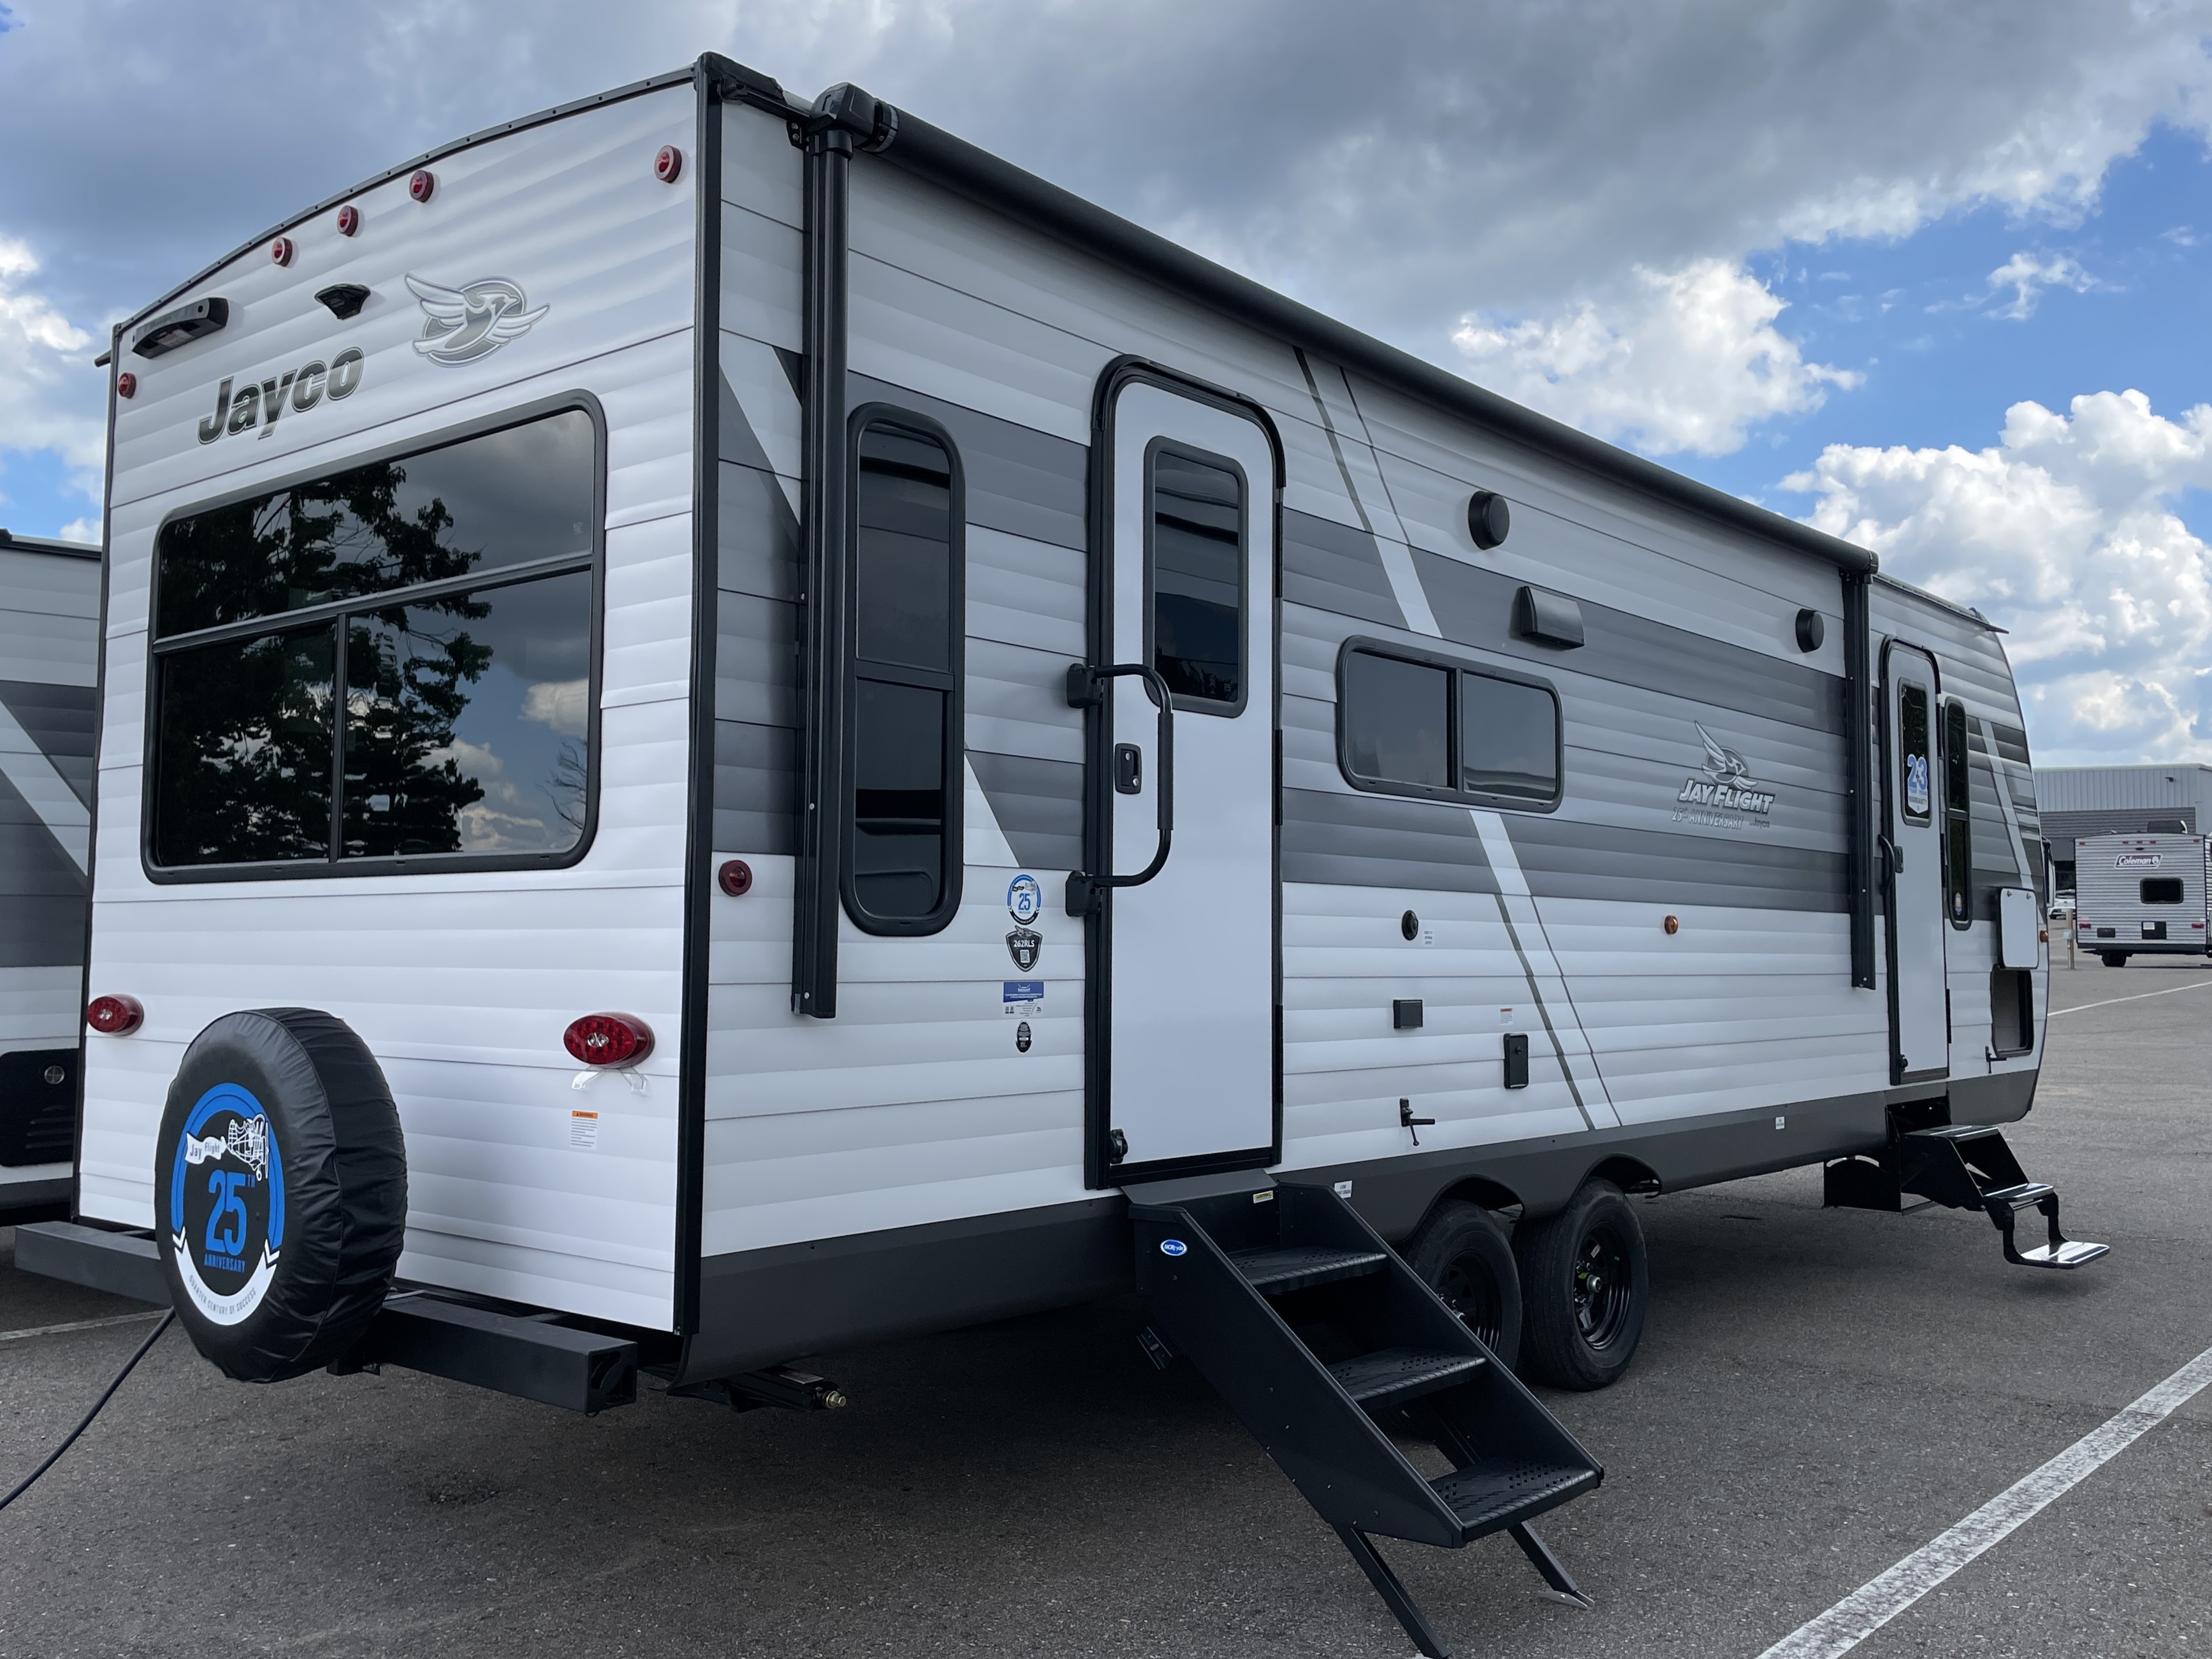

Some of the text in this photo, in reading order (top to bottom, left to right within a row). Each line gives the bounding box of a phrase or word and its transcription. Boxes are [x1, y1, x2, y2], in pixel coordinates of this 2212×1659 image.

[198, 346, 365, 445] Jayco
[1678, 778, 1776, 815] JAY FLIGHT
[1671, 807, 1689, 823] 25th
[1689, 808, 1744, 830] ANNIVERSARY
[2118, 856, 2151, 866] Coleman
[1013, 939, 1035, 948] 262RLS
[189, 1142, 221, 1160] Jay Flight
[203, 1253, 246, 1274] ANNIVERSARY
[189, 1275, 256, 1315] QUARTER CENTURY OF SUCCESS
